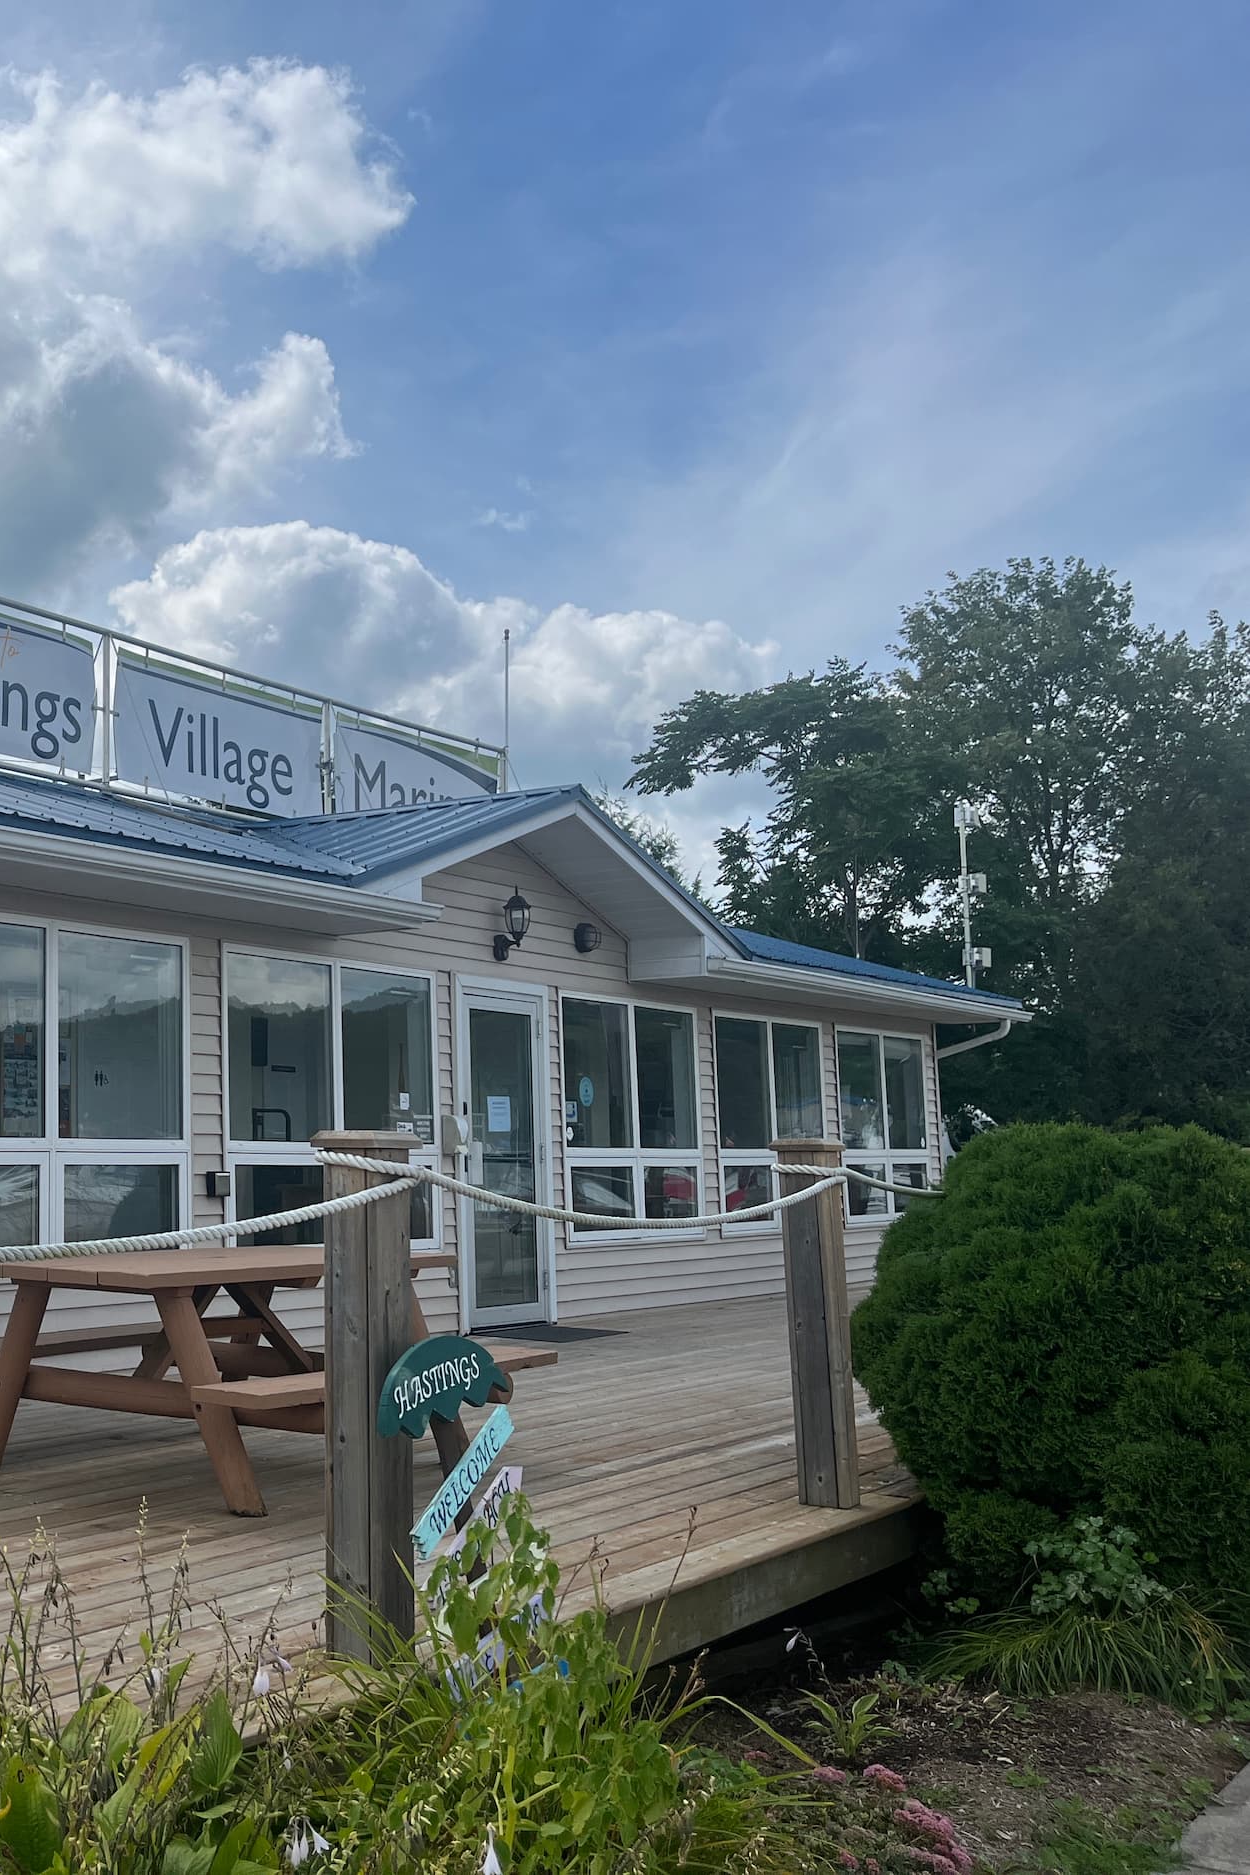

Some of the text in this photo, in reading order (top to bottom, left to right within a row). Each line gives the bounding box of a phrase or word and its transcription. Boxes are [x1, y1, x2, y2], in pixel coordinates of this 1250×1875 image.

[148, 698, 293, 809] Village
[354, 753, 454, 812] Mari
[393, 1352, 480, 1419] HASTINGS
[429, 1427, 500, 1535] WELCOME
